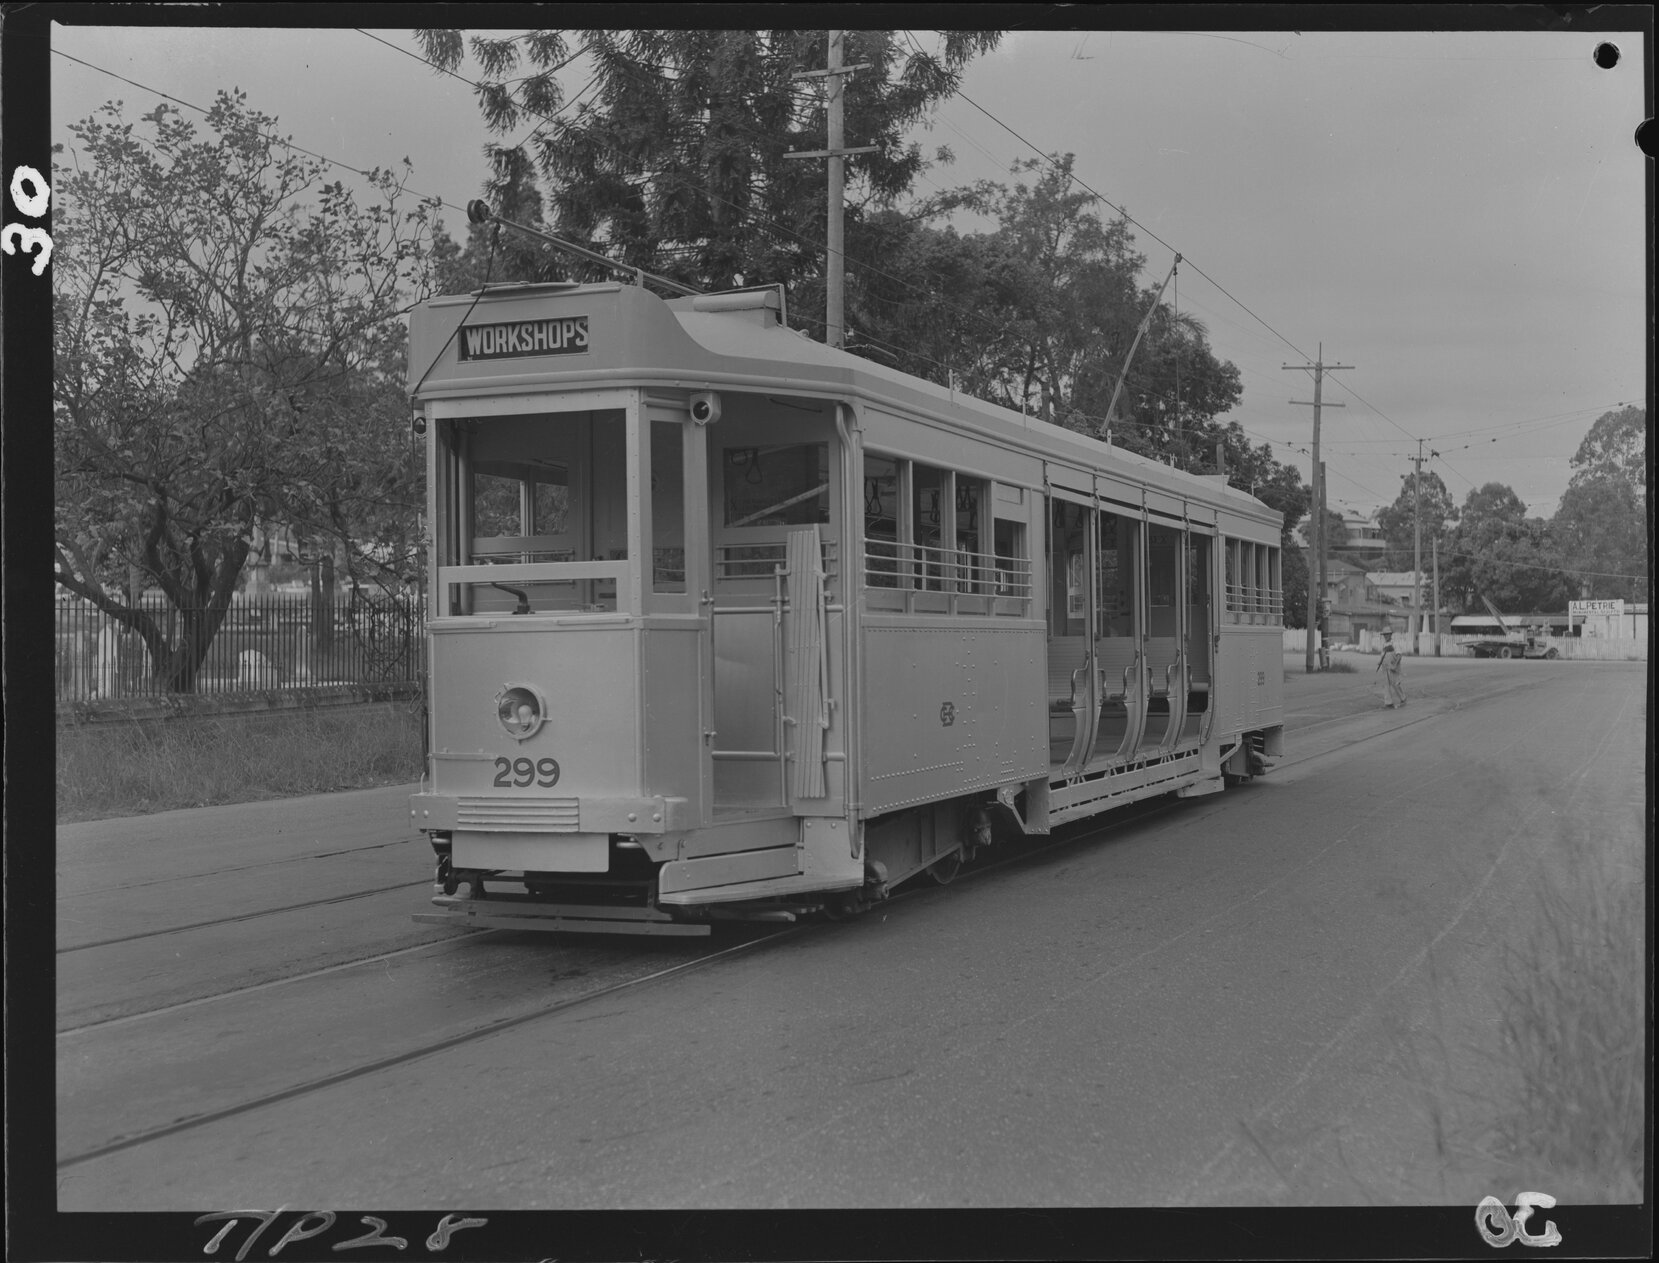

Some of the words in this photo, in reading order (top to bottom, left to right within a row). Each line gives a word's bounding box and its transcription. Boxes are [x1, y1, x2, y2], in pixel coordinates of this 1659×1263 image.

[0, 165, 54, 277] 30
[465, 319, 588, 356] WORKSHOPS
[493, 756, 561, 788] 299
